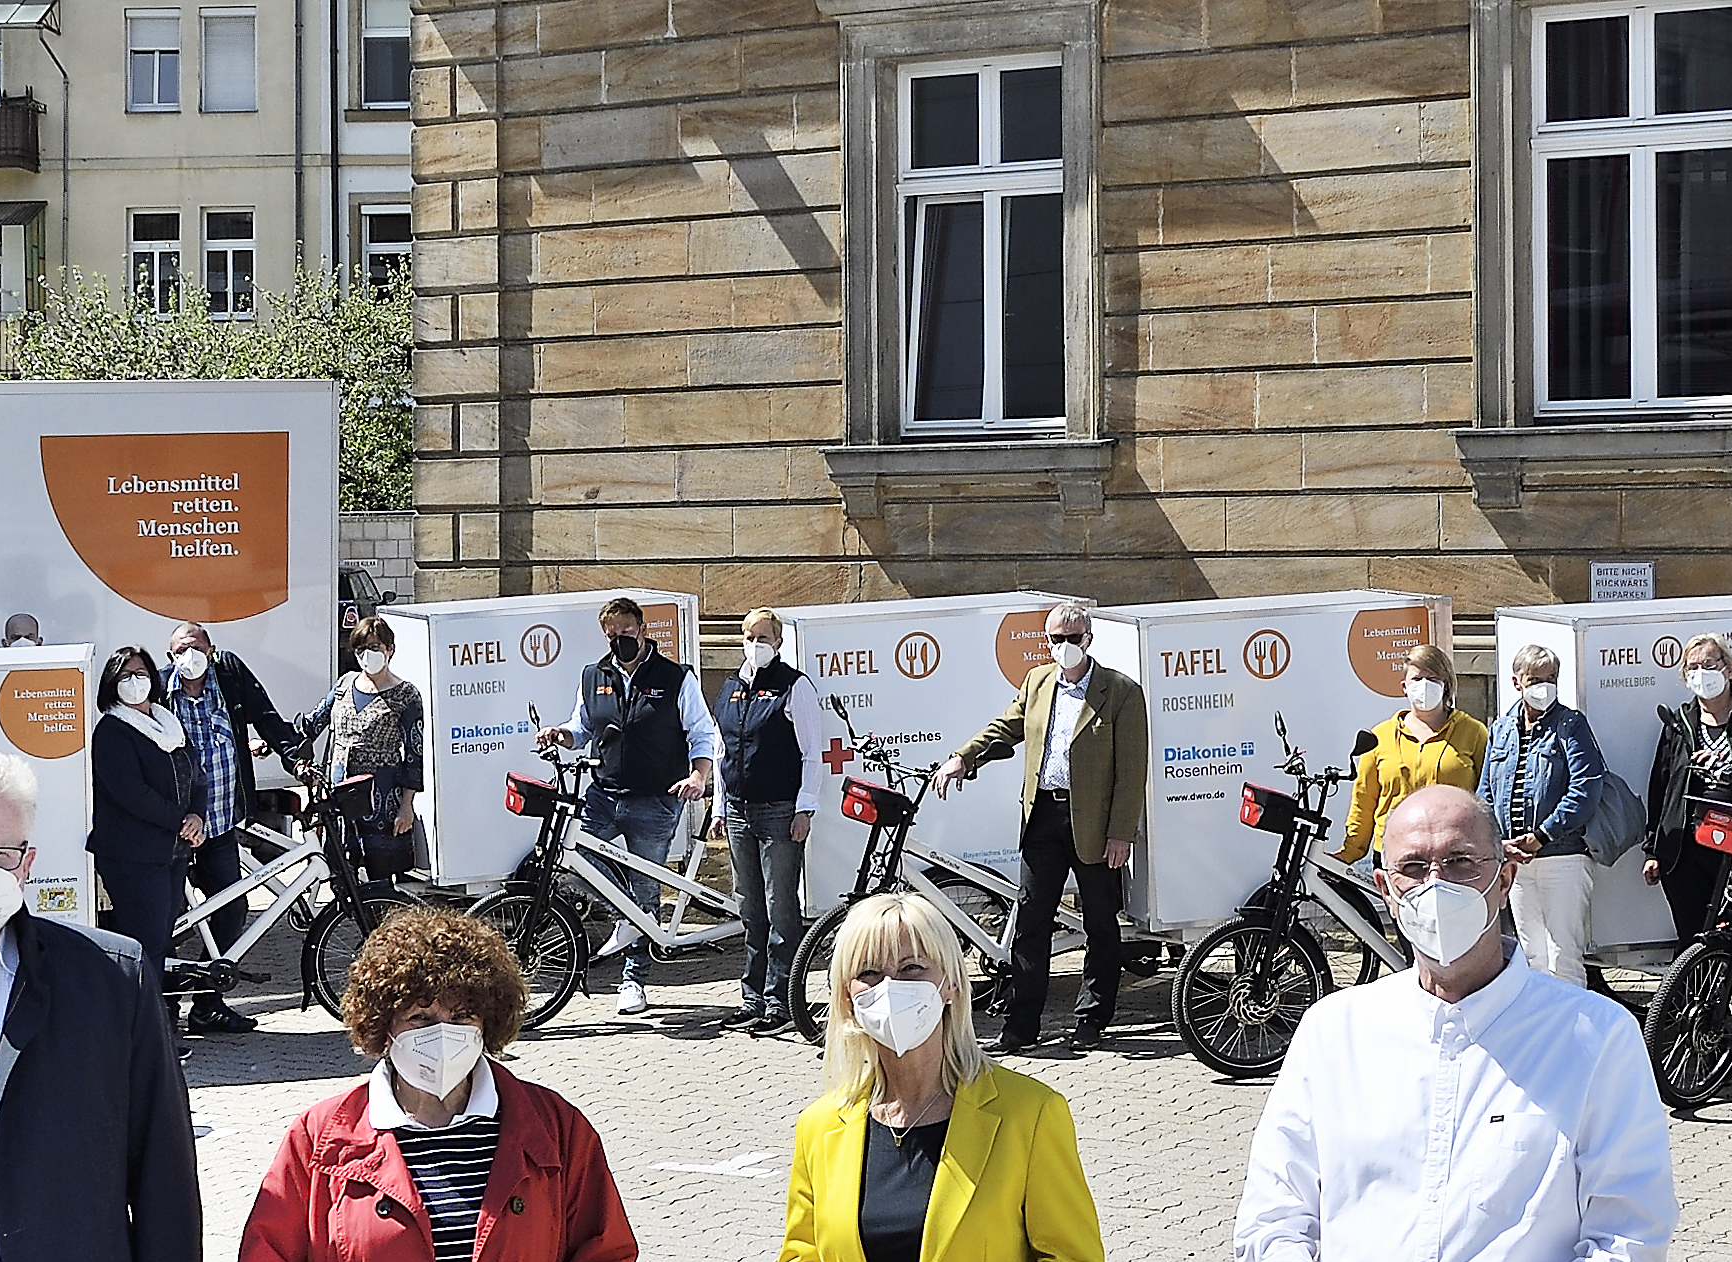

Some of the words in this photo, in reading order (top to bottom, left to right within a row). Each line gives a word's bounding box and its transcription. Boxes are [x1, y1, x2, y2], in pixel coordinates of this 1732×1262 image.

[107, 473, 239, 494] Lebensmittel
[172, 497, 239, 514] retten.
[137, 516, 239, 537] Menschen
[170, 539, 239, 558] helfen.
[1597, 568, 1619, 576] BITTE
[1622, 568, 1646, 576] NICHT
[1597, 591, 1647, 599] EINPARKEN
[1363, 625, 1421, 638] Lebensmittel
[449, 641, 506, 667] TAFEL
[1600, 648, 1642, 666] TAFEL
[816, 649, 879, 677] TAFEL
[1161, 649, 1227, 677] TAFEL
[450, 680, 505, 697] ERLANGEN
[1600, 676, 1656, 689] HAMMELBURG
[13, 688, 75, 699] Lebensmittel
[817, 693, 873, 711] KEPTEN
[44, 700, 75, 709] retten.
[1162, 693, 1234, 712] ROSENHEIM
[27, 711, 76, 722] Menschen
[43, 723, 76, 733] helfen.
[451, 723, 514, 740] Diakonie
[451, 741, 505, 755] Erlangen
[1164, 744, 1237, 762] Diakonie
[1165, 762, 1243, 779] Rosenheim
[1166, 790, 1225, 802] www.dwro.de
